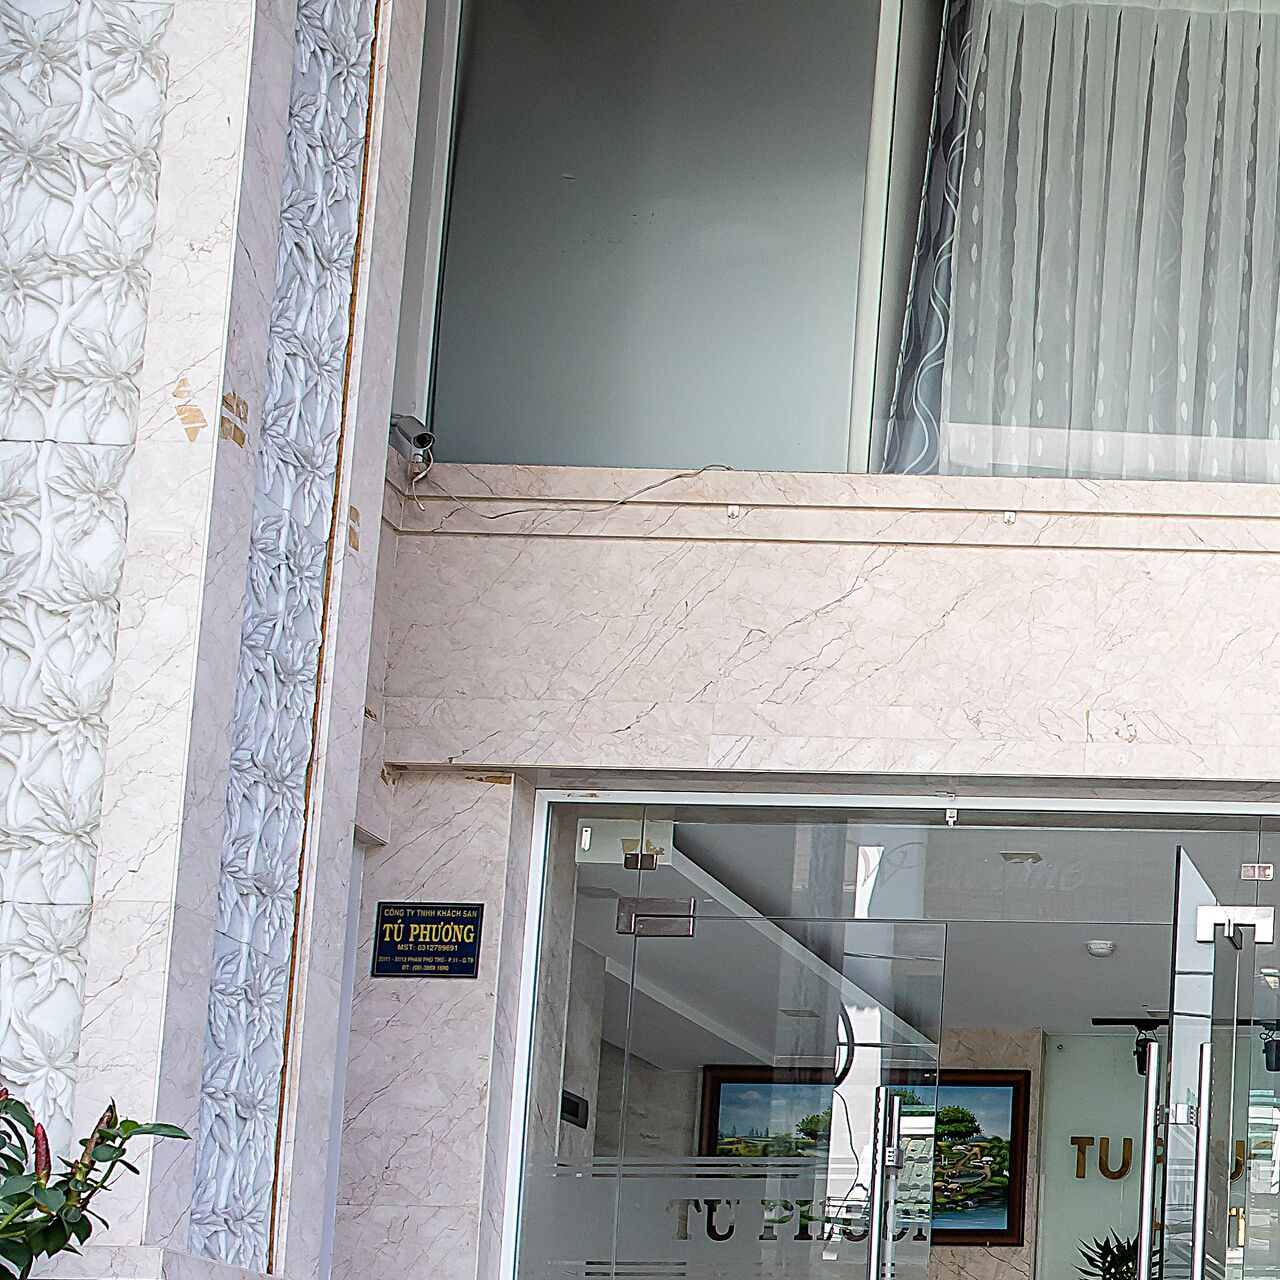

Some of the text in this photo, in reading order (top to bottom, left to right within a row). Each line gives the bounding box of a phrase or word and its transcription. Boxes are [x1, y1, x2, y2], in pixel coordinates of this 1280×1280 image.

[384, 908, 404, 917] CÔNG
[406, 908, 416, 917] TY
[417, 909, 436, 917] TNHH
[383, 919, 475, 943] TÚ PHƯƠNG
[1070, 1136, 1134, 1180] TU
[665, 1198, 741, 1242] TU
